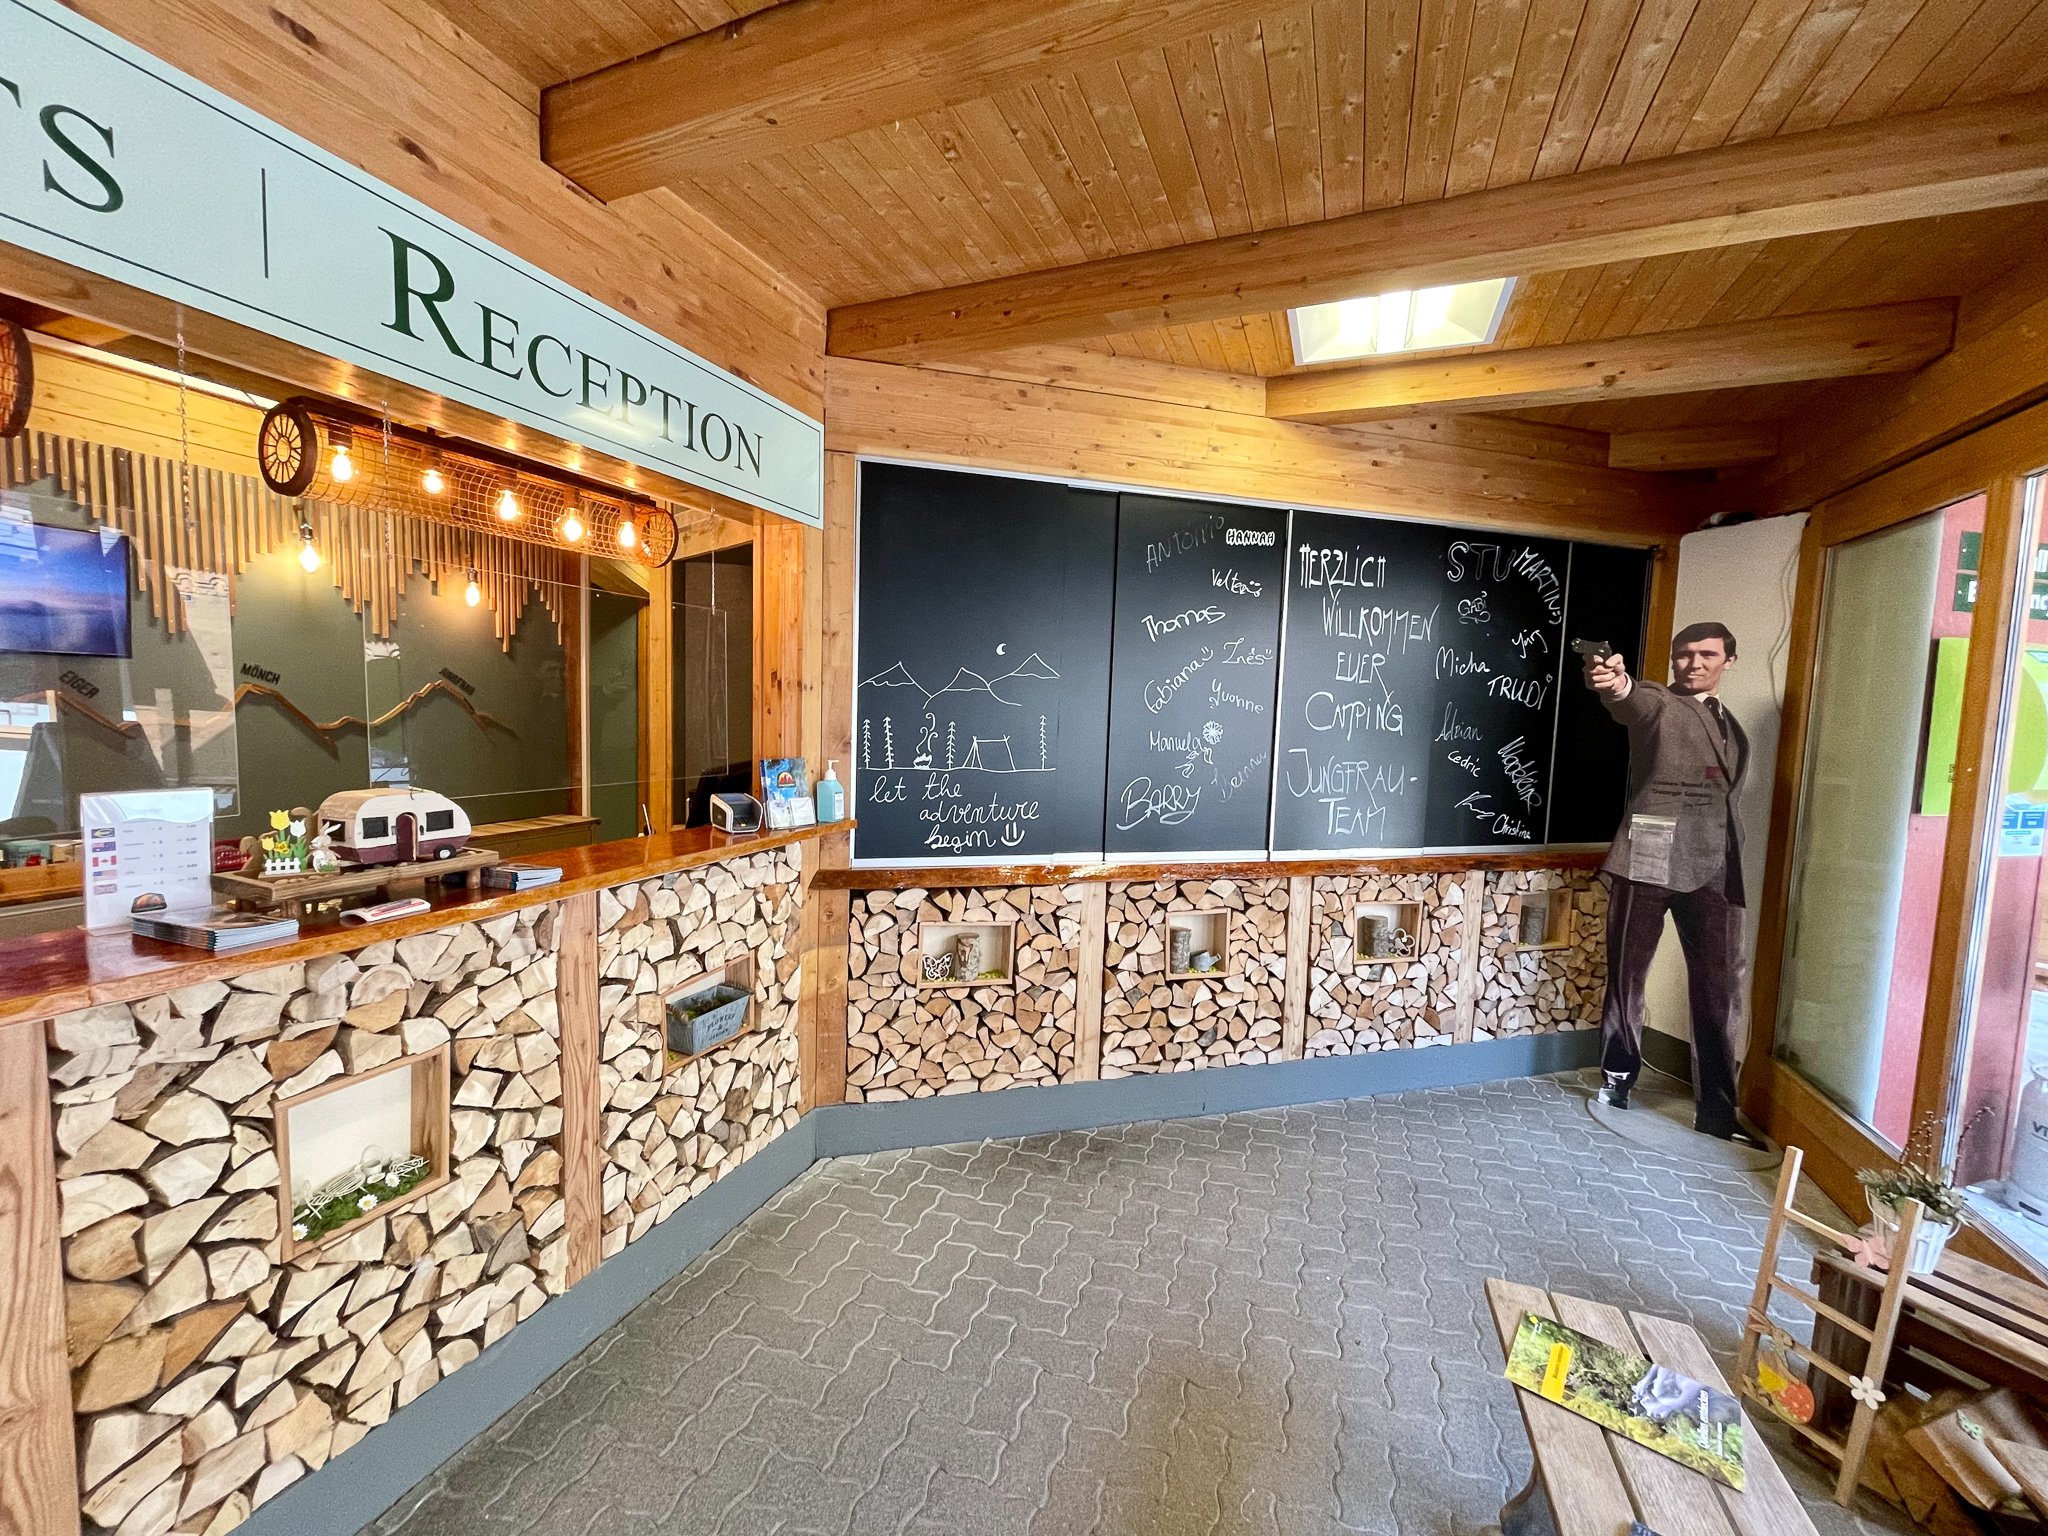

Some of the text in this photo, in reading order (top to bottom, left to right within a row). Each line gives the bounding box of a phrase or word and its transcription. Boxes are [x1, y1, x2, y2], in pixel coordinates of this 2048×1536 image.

[377, 225, 764, 480] RECEPTION
[1226, 528, 1276, 546] HANNAH
[1298, 543, 1387, 597] HERZLICH
[1446, 540, 1517, 583] STU
[1513, 546, 1561, 611] MARTIN
[1141, 605, 1226, 642] Thomas
[1322, 589, 1440, 655] WILLKOMMEN
[239, 663, 281, 685] MÖNCH
[1335, 651, 1388, 694] EUER
[1435, 645, 1491, 680] Micha
[58, 669, 100, 699] EIGER
[1144, 658, 1205, 714] Fabiana
[1210, 678, 1264, 714] Yvonne
[1434, 701, 1484, 742] Adrian
[1149, 730, 1204, 752] Manuela
[869, 772, 963, 803] let the
[919, 792, 1040, 824] adventure
[1317, 797, 1387, 843] TEAM
[923, 823, 997, 853] begin
[1492, 813, 1531, 840] Christine
